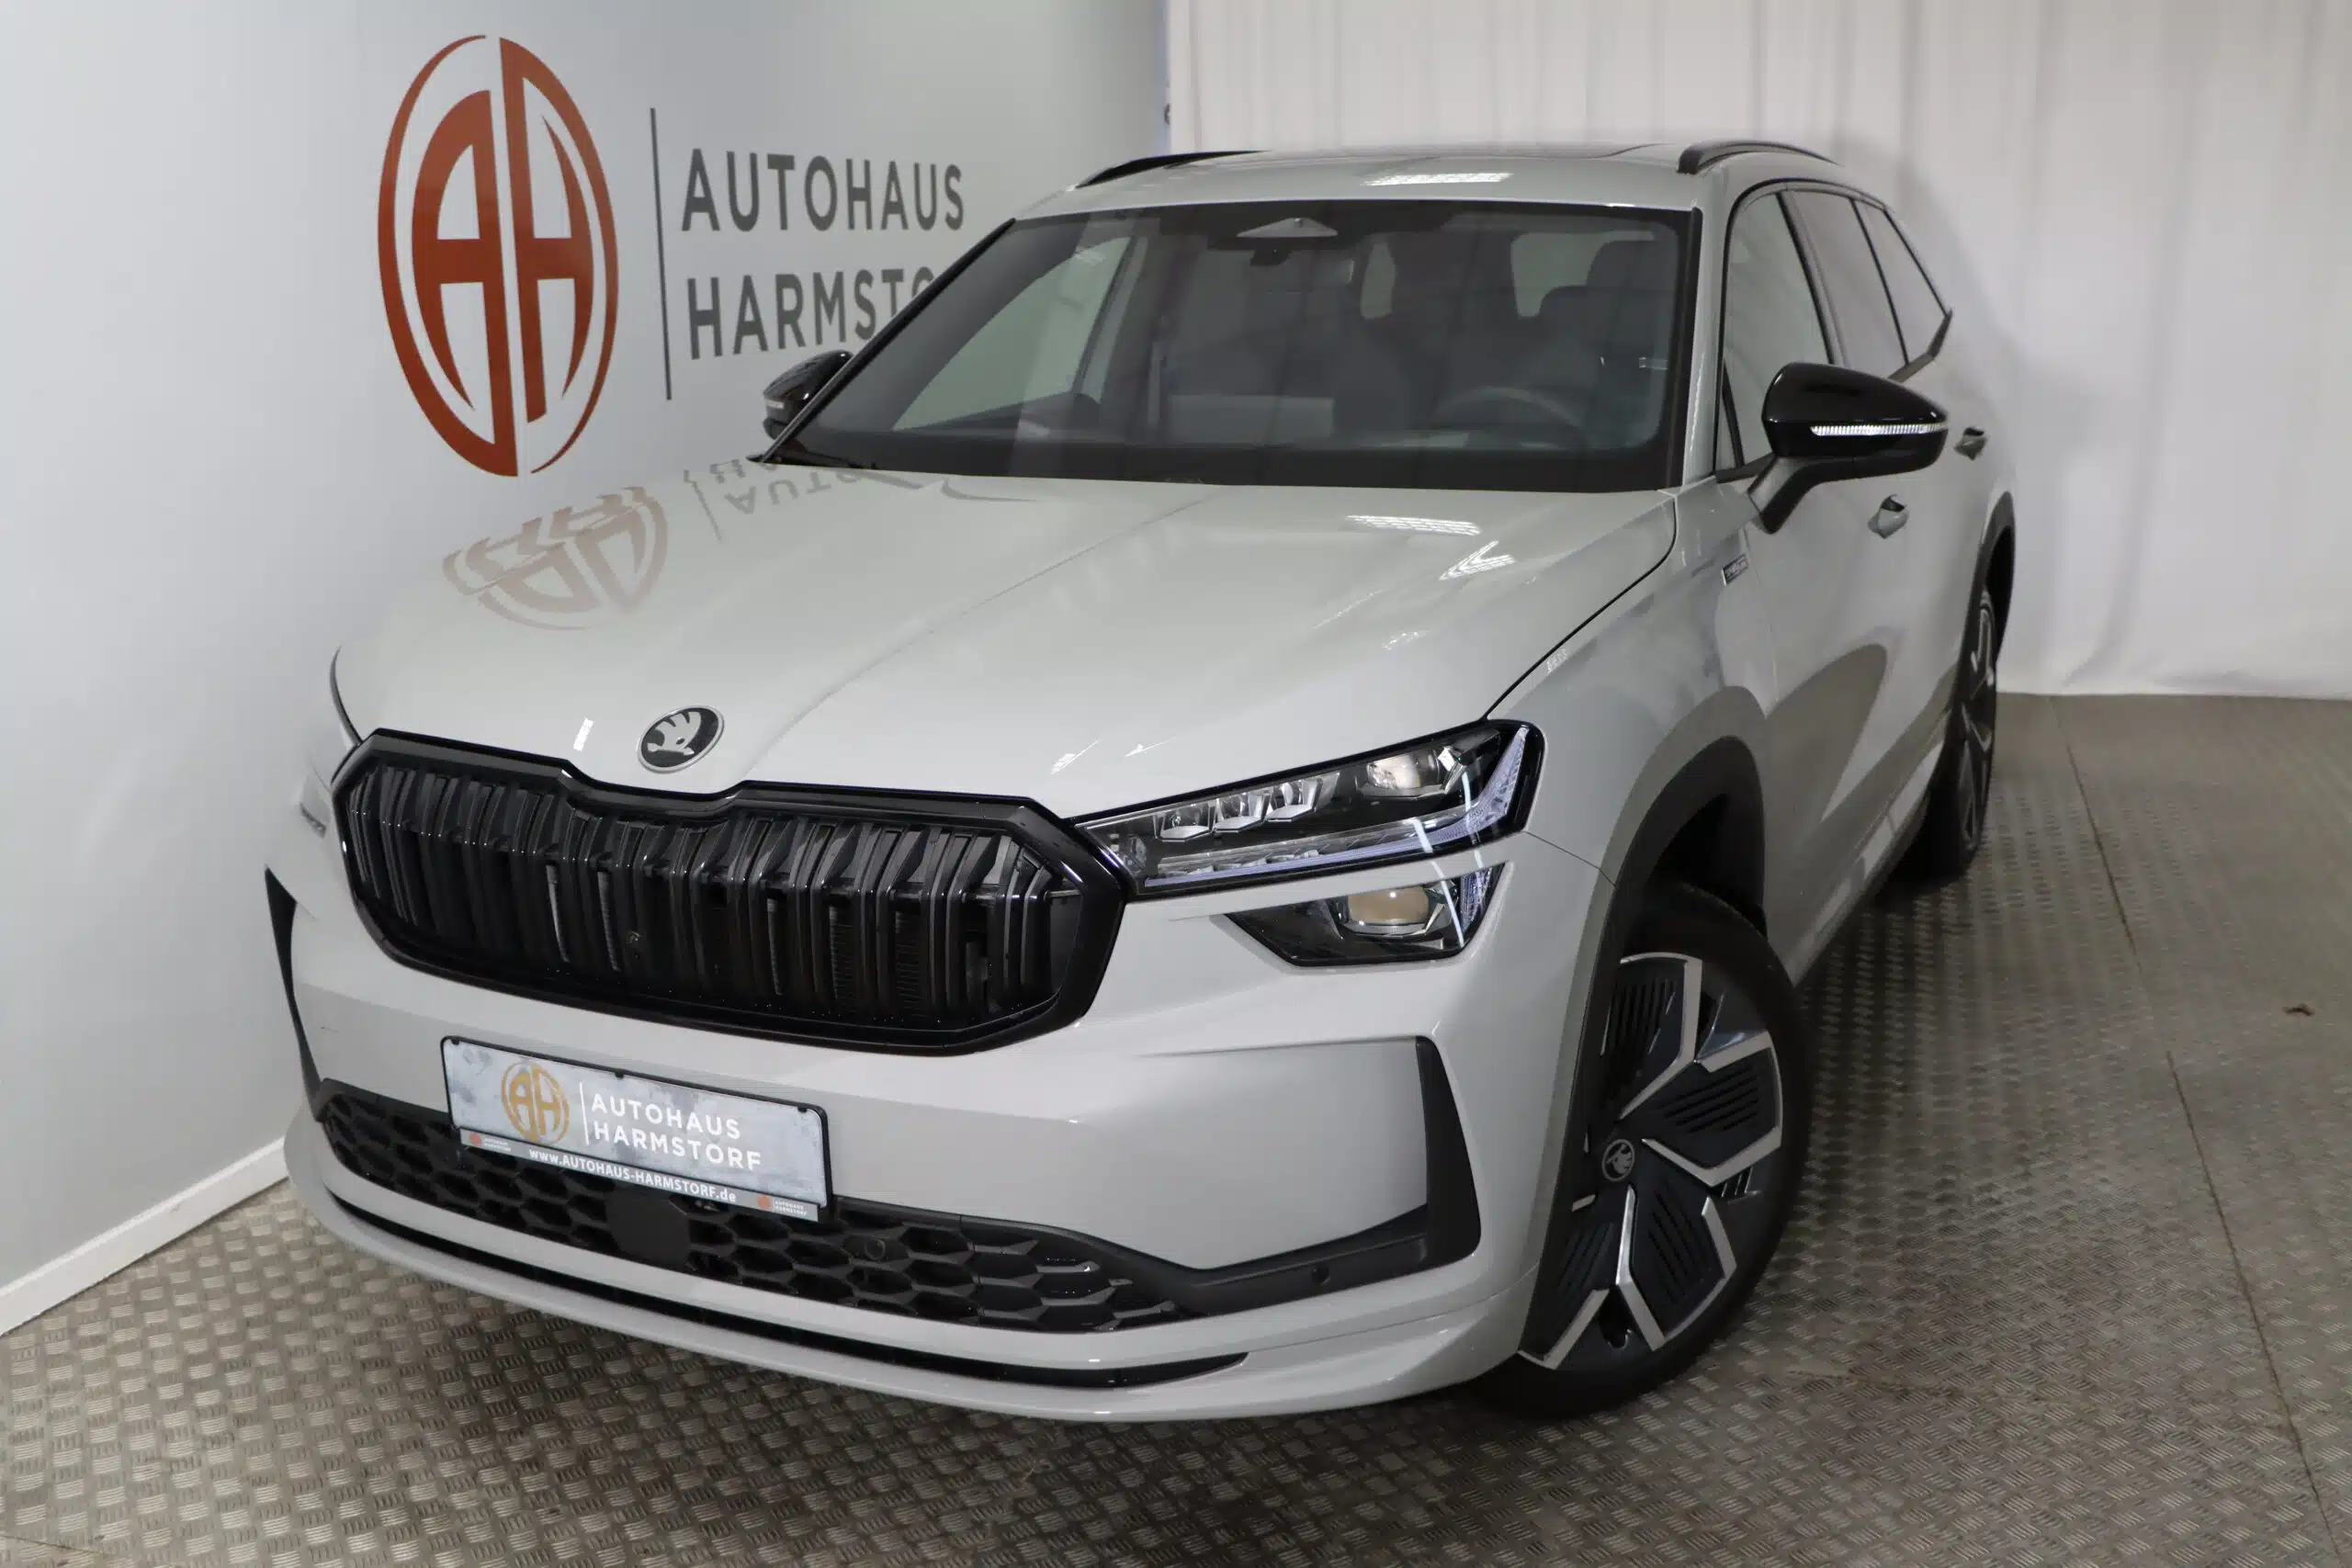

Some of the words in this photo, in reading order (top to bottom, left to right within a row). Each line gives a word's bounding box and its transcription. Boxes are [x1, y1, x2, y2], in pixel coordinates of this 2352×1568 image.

[682, 147, 964, 231] AUTOHAUS
[591, 1092, 741, 1140] AUTOHAUS
[594, 1120, 762, 1171] HARMSTORF
[528, 1148, 737, 1203] www.AUTOHAUS-HARMSTORF.de
